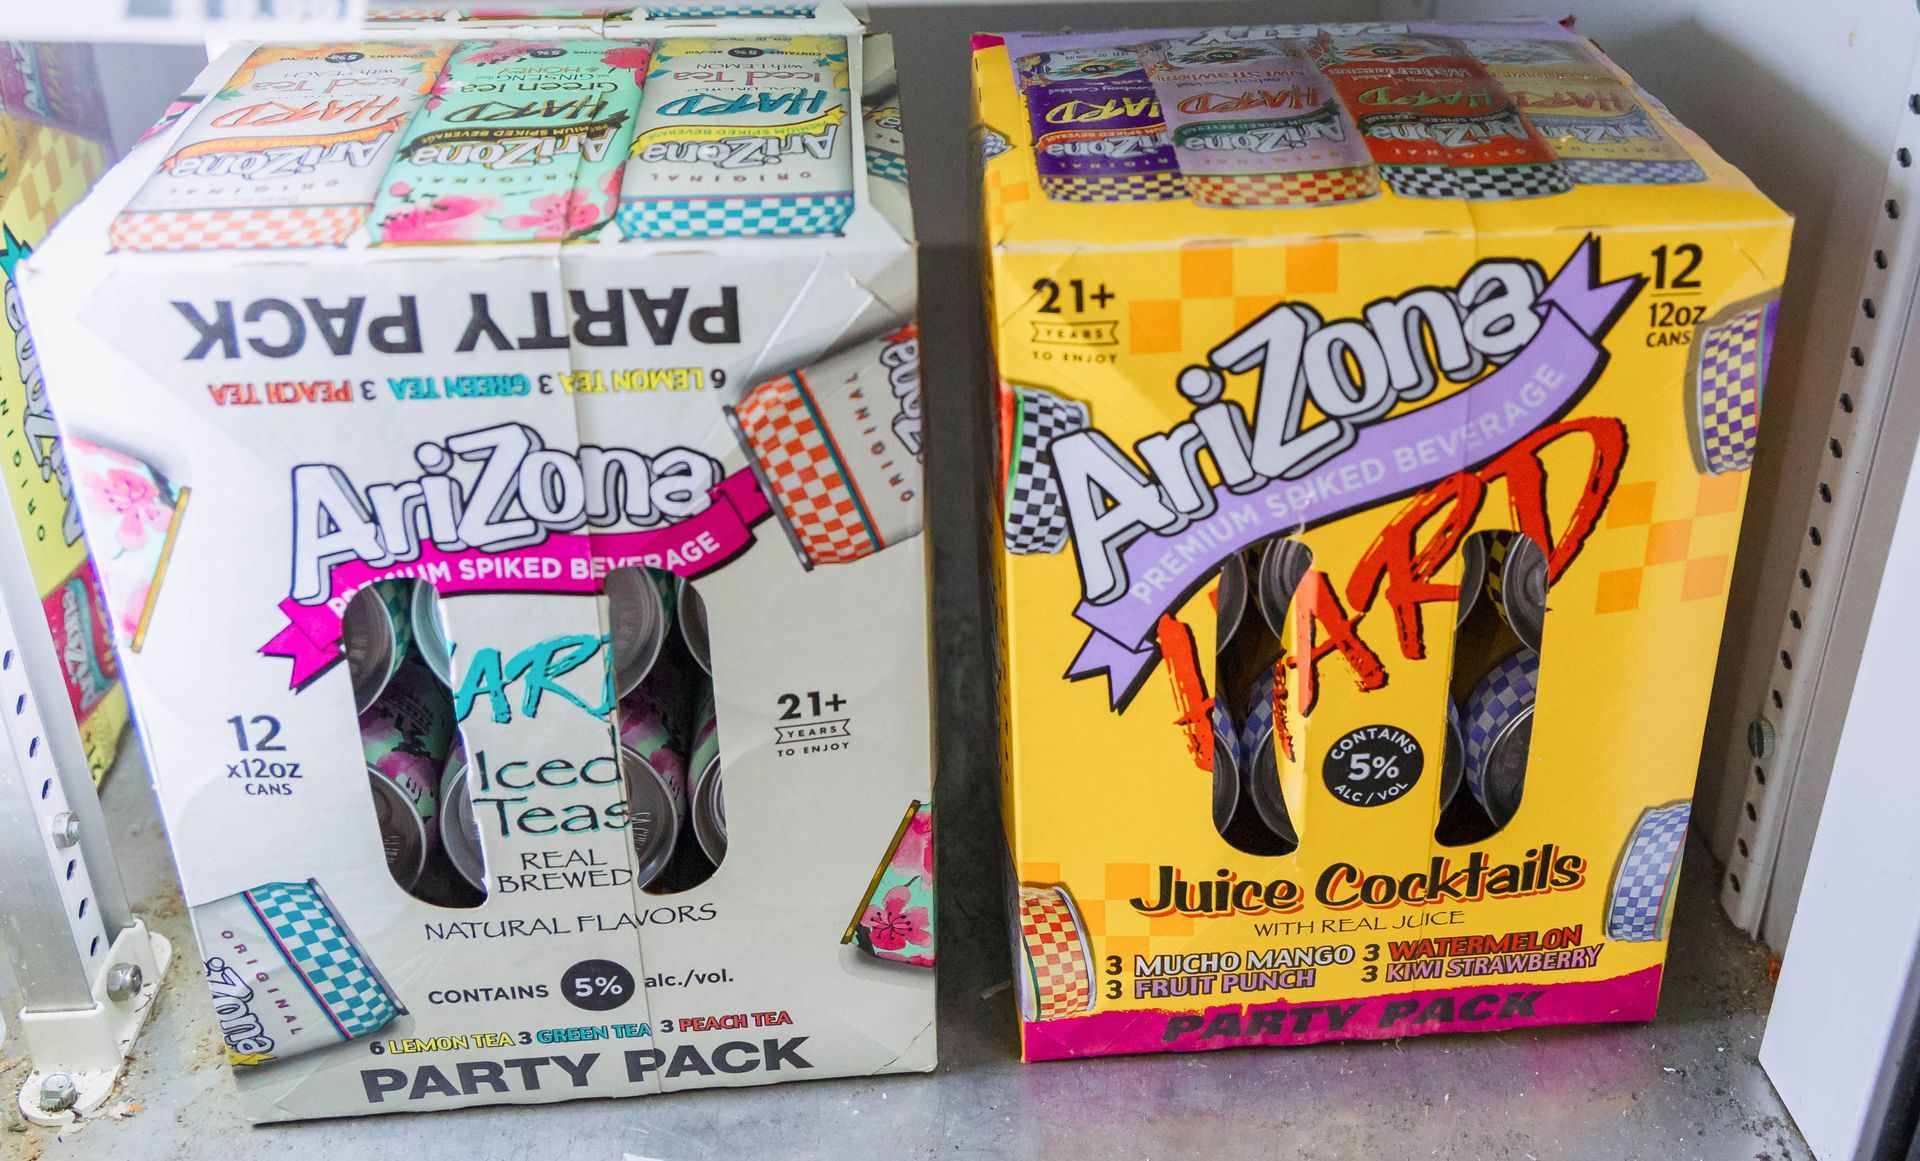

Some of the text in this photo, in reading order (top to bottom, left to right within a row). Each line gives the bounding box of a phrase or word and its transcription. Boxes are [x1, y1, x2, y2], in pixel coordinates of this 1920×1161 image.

[496, 73, 595, 81] GINSENG
[497, 66, 581, 75] HONEY
[674, 71, 821, 86] Iced Tea
[696, 63, 803, 72] with LEMON
[252, 80, 315, 92] Tea
[518, 81, 618, 95] Green
[1177, 86, 1320, 115] HARD
[211, 97, 401, 128] HARD
[657, 88, 829, 117] HARD
[410, 127, 619, 171] AriZona
[420, 130, 490, 144] BEVERAGE
[493, 128, 549, 138] SPIKED
[639, 123, 839, 170] AriZona
[647, 128, 713, 142] BEVERAGE
[715, 128, 771, 138] SPIKED
[1046, 132, 1097, 142] BEVERAGE
[1184, 116, 1346, 154] AriZona
[167, 131, 394, 181] AriZona
[650, 172, 811, 183] ORIGINAL
[1650, 243, 1703, 290] 12
[1032, 278, 1115, 313] 21+
[170, 286, 741, 360] PARTY PACK
[1046, 328, 1104, 339] YEARS
[1646, 330, 1692, 348] CANS
[1032, 350, 1117, 365] TO ENJOY
[207, 366, 727, 406] 6 LEMON TEA 3 GREEN TEA 3 PEACH TEA
[845, 372, 915, 502] ORIGINAL
[1049, 257, 1550, 606] AriZona
[1130, 361, 1565, 605] PREMIUM SPIKED BEVERAGE
[290, 421, 726, 606] AriZona
[459, 557, 561, 581] SPIKED
[450, 634, 618, 724] AR
[777, 691, 847, 721] 21+
[226, 714, 287, 751] 12
[787, 725, 838, 738] YEARS
[1330, 727, 1417, 760] CONTAINS
[474, 726, 624, 792] Iced
[777, 741, 850, 757] TO ENJOY
[1347, 753, 1400, 781] 5%
[244, 783, 293, 796] CANS
[472, 796, 633, 838] Teas
[520, 848, 609, 871] REAL
[496, 868, 634, 894] BREWED
[1130, 843, 1588, 917] Juice Cocktails
[424, 902, 718, 941] NATURAL FLAVORS
[1253, 910, 1466, 937] WITH REAL JUICE
[1362, 923, 1584, 961] 3 WATERMELON
[1105, 943, 1355, 979] 3 MUCHO MANGO
[1360, 943, 1605, 983] 3 KIWI STRAWBERRY
[221, 930, 303, 1035] ORIGINAL
[427, 968, 734, 1005] CONTAINS 5% alc./vol.
[1105, 967, 1317, 999] 3 FRUIT PUNCH
[1162, 989, 1546, 1043] PARTY PACK
[369, 1010, 794, 1056] 6 LEMON TEA 3 GREEN TEA 3 PEACH TEA
[359, 1036, 816, 1104] PARTY PACK
